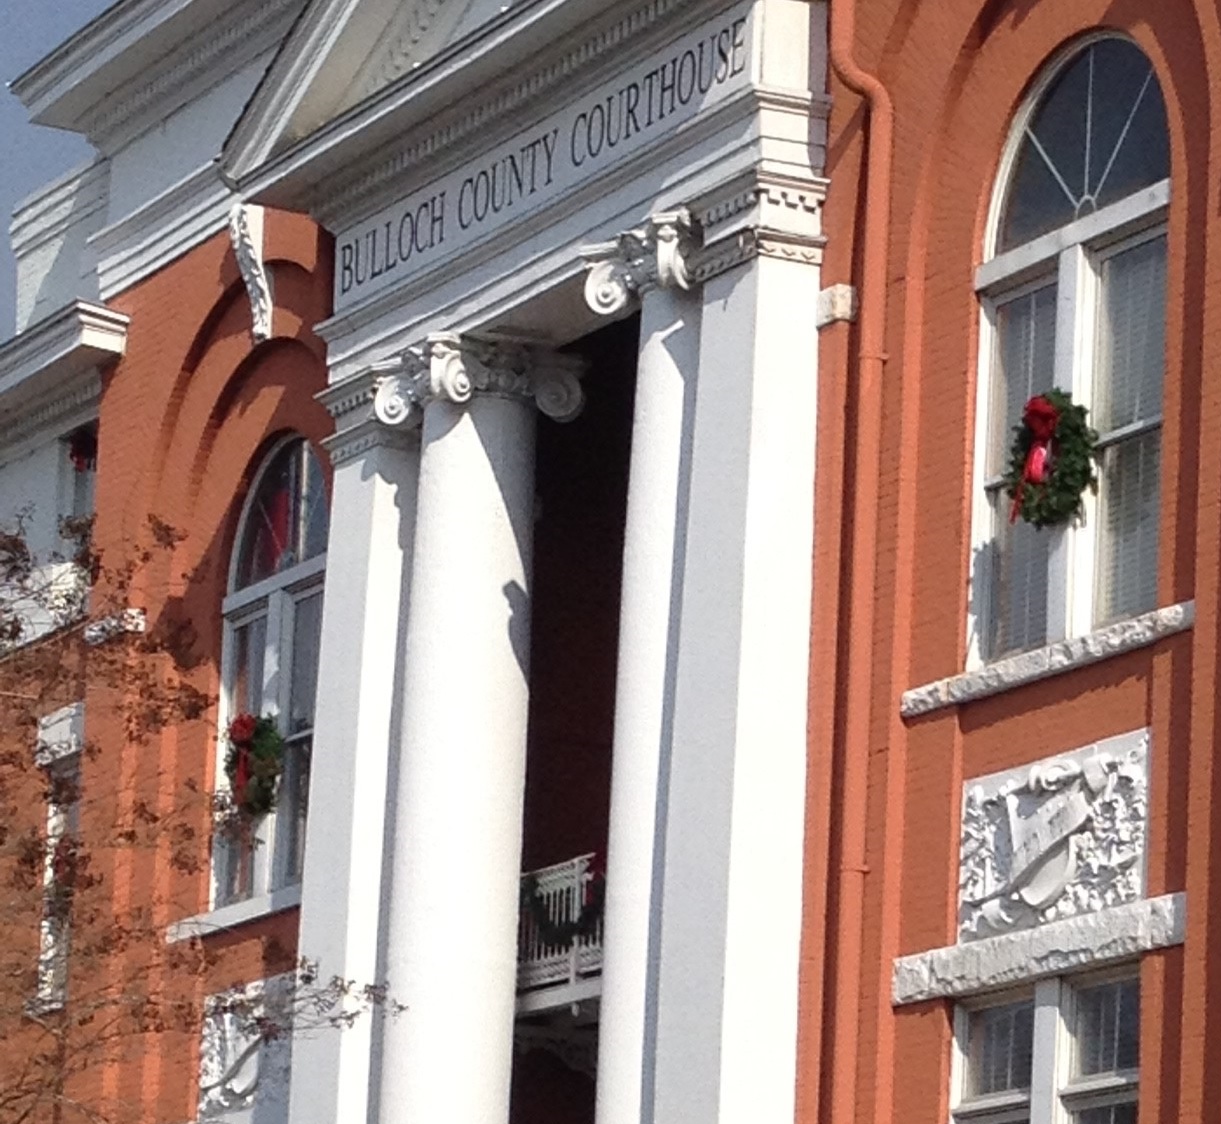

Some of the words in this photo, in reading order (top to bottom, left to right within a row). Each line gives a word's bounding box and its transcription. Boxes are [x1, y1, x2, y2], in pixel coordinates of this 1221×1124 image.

[341, 191, 446, 294] BULLOCH
[457, 130, 559, 230] COUNTY
[570, 17, 747, 167] COURTHOUSE
